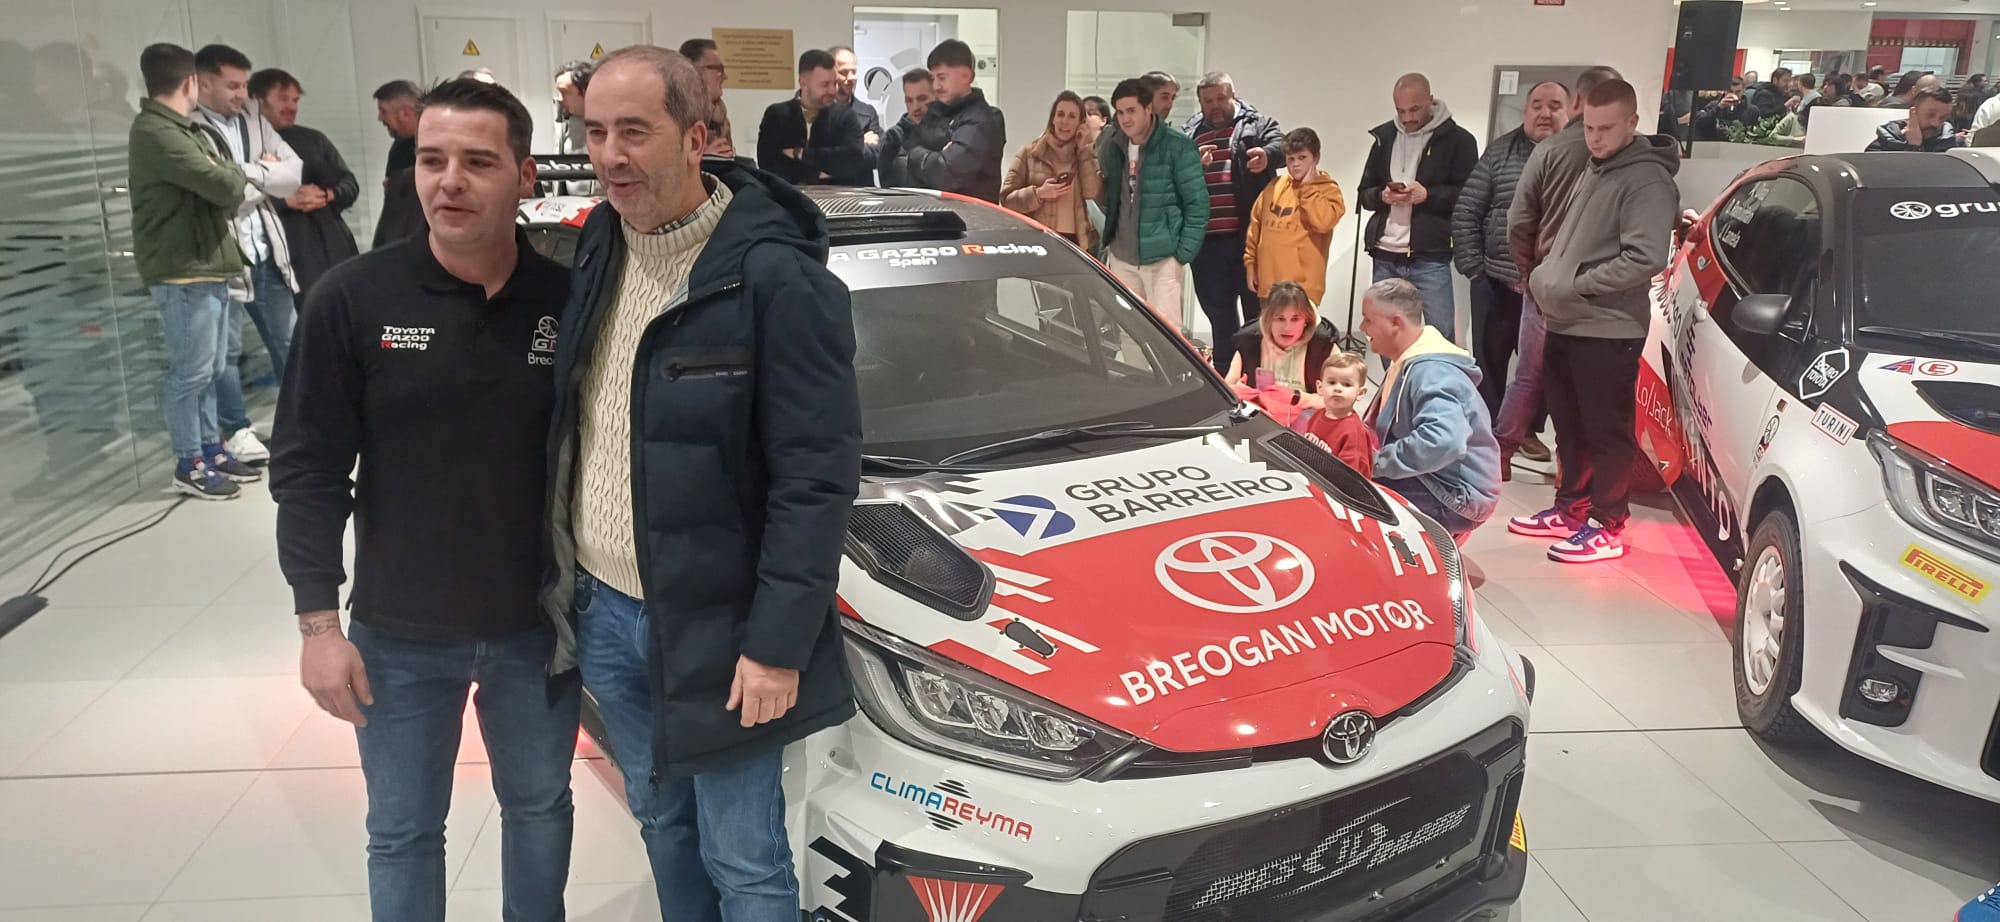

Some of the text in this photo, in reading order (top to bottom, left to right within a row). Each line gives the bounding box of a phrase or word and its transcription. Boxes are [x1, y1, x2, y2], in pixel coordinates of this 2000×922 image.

[1934, 201, 2000, 217] gru
[856, 245, 959, 260] GAZOO
[961, 242, 1048, 256] Racing
[889, 256, 938, 269] Spain
[381, 333, 430, 341] GAZOO
[383, 325, 436, 335] TOYOTA
[381, 340, 428, 351] Racing
[1806, 368, 1829, 389] TOYOTA
[1816, 409, 1852, 440] TURINI
[1064, 465, 1212, 501] GRUPO
[1086, 476, 1294, 524] BARREIRO
[1904, 548, 1985, 599] PIRELLI
[1119, 598, 1435, 706] BREOGAN MOTOR
[869, 771, 1034, 842] CLIMAREYMA
